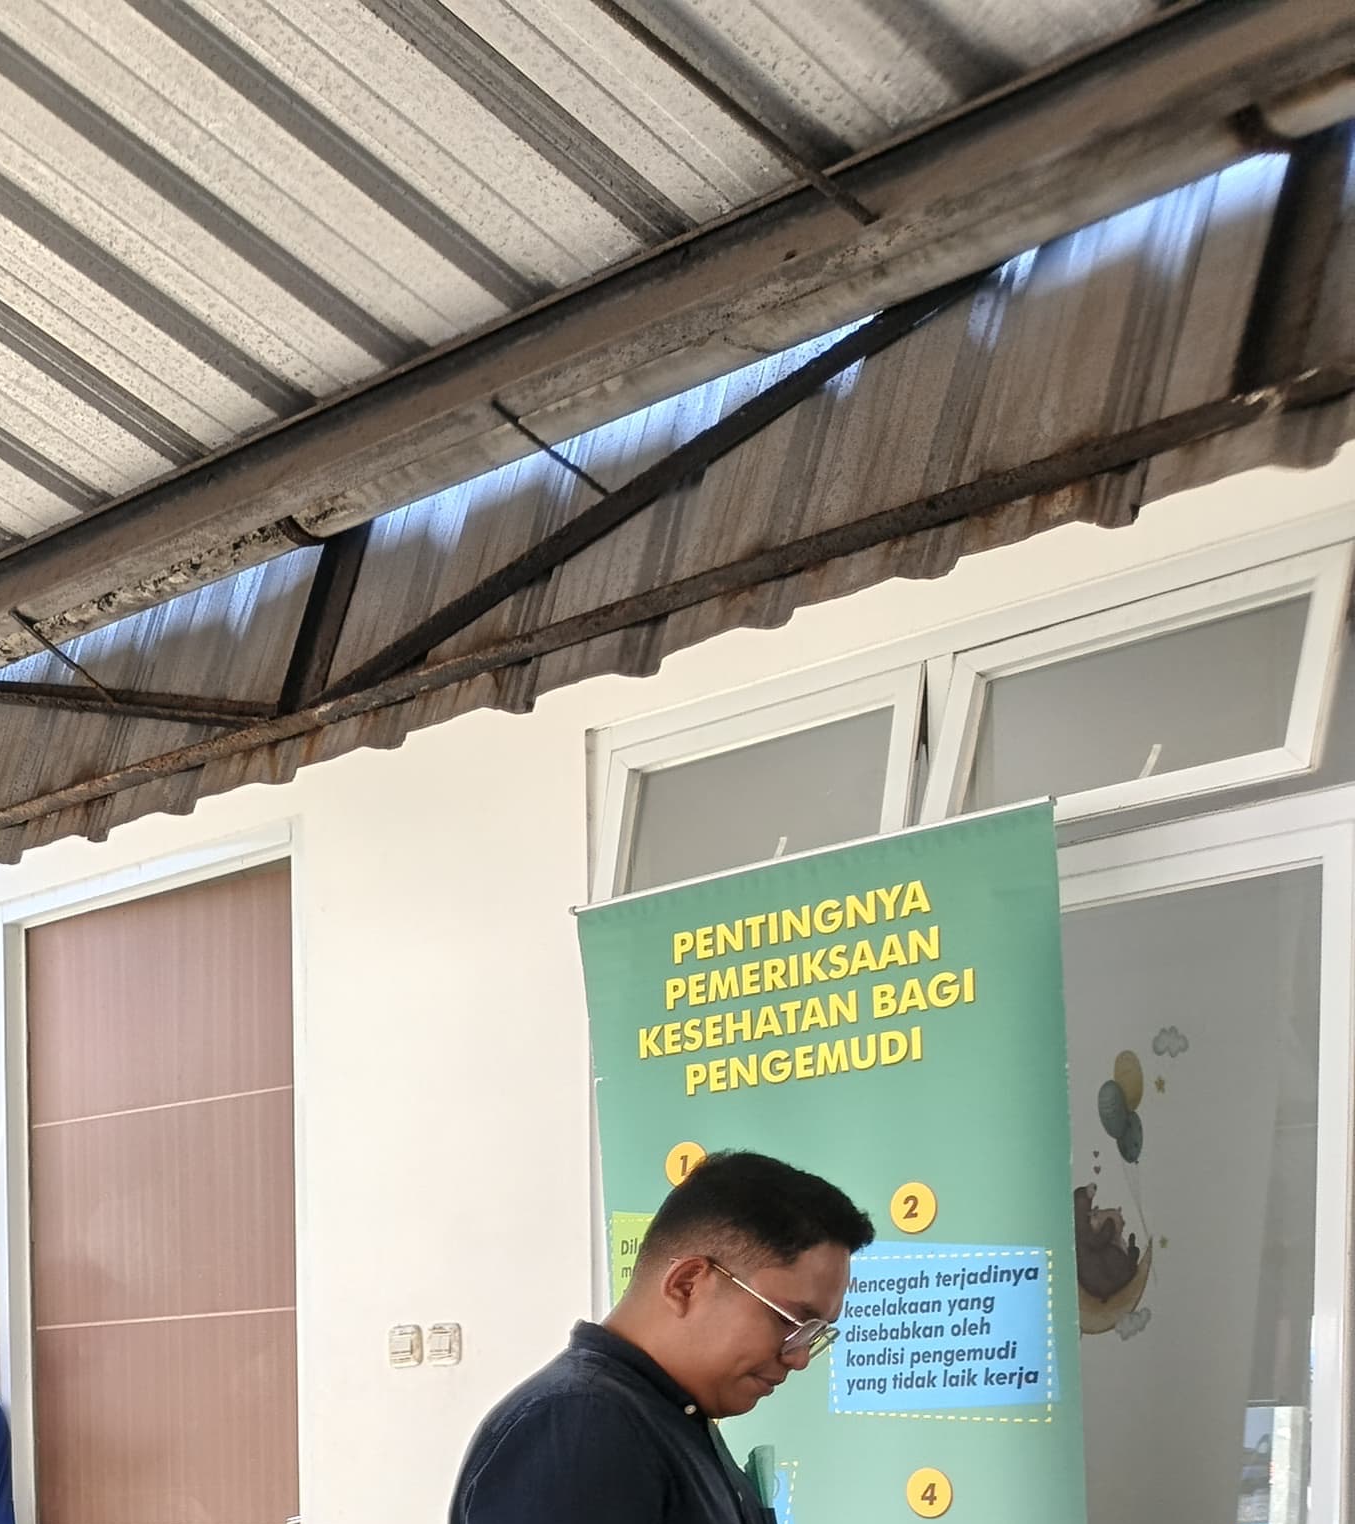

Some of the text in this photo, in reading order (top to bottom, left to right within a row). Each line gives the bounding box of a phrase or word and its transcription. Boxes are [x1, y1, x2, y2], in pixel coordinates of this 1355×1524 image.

[673, 879, 931, 963] PENTINGNYA
[665, 926, 941, 1009] PEMERIKSAAN
[638, 968, 976, 1059] KESEHATAN BAGI
[686, 1027, 923, 1095] PENGEMUDI
[903, 1195, 919, 1220] 2
[847, 1264, 1039, 1295] Mencegah terjadinya
[844, 1295, 995, 1318] kecelakaan yang
[845, 1316, 991, 1343] disebabkan oleh
[846, 1340, 1017, 1368] kondisi pengemudi
[846, 1366, 1039, 1395] yang tidak laik kerja
[921, 1482, 937, 1507] 4
